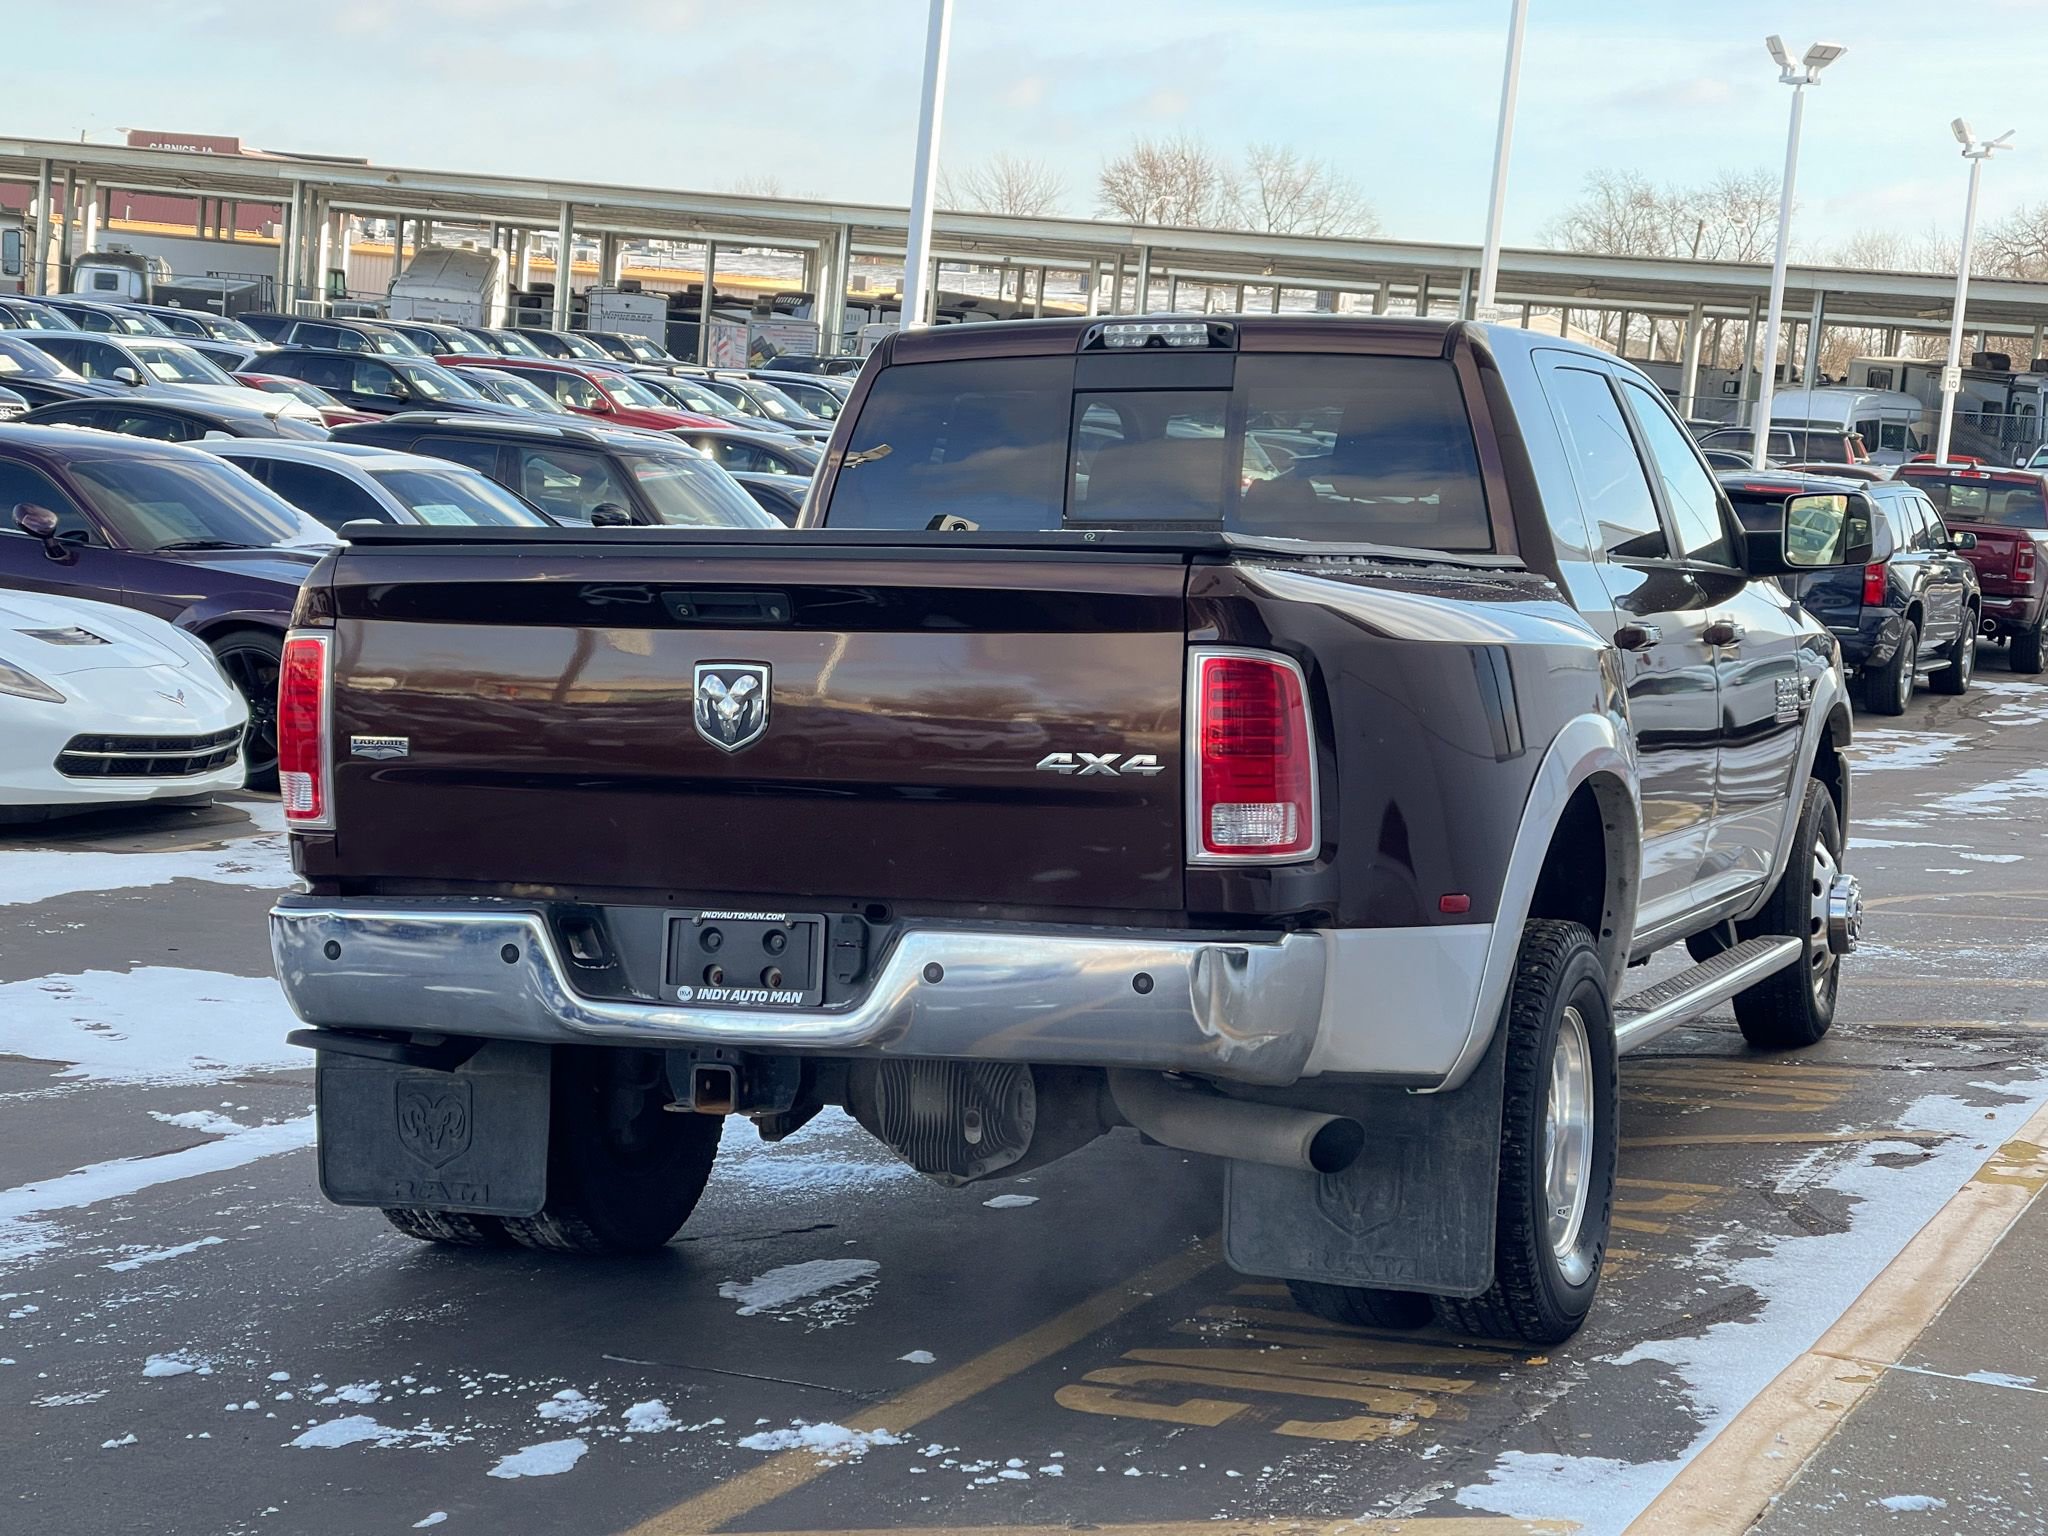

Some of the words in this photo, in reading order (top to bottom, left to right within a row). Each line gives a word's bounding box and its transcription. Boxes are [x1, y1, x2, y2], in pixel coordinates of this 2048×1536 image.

[1948, 380, 1958, 389] 10
[353, 738, 407, 746] LARAMIE
[701, 911, 786, 921] INDYAUTOMAN.COM
[696, 988, 731, 1000] INDY
[730, 989, 769, 1003] AUTO
[769, 990, 804, 1004] MAN
[394, 1179, 490, 1203] RAM
